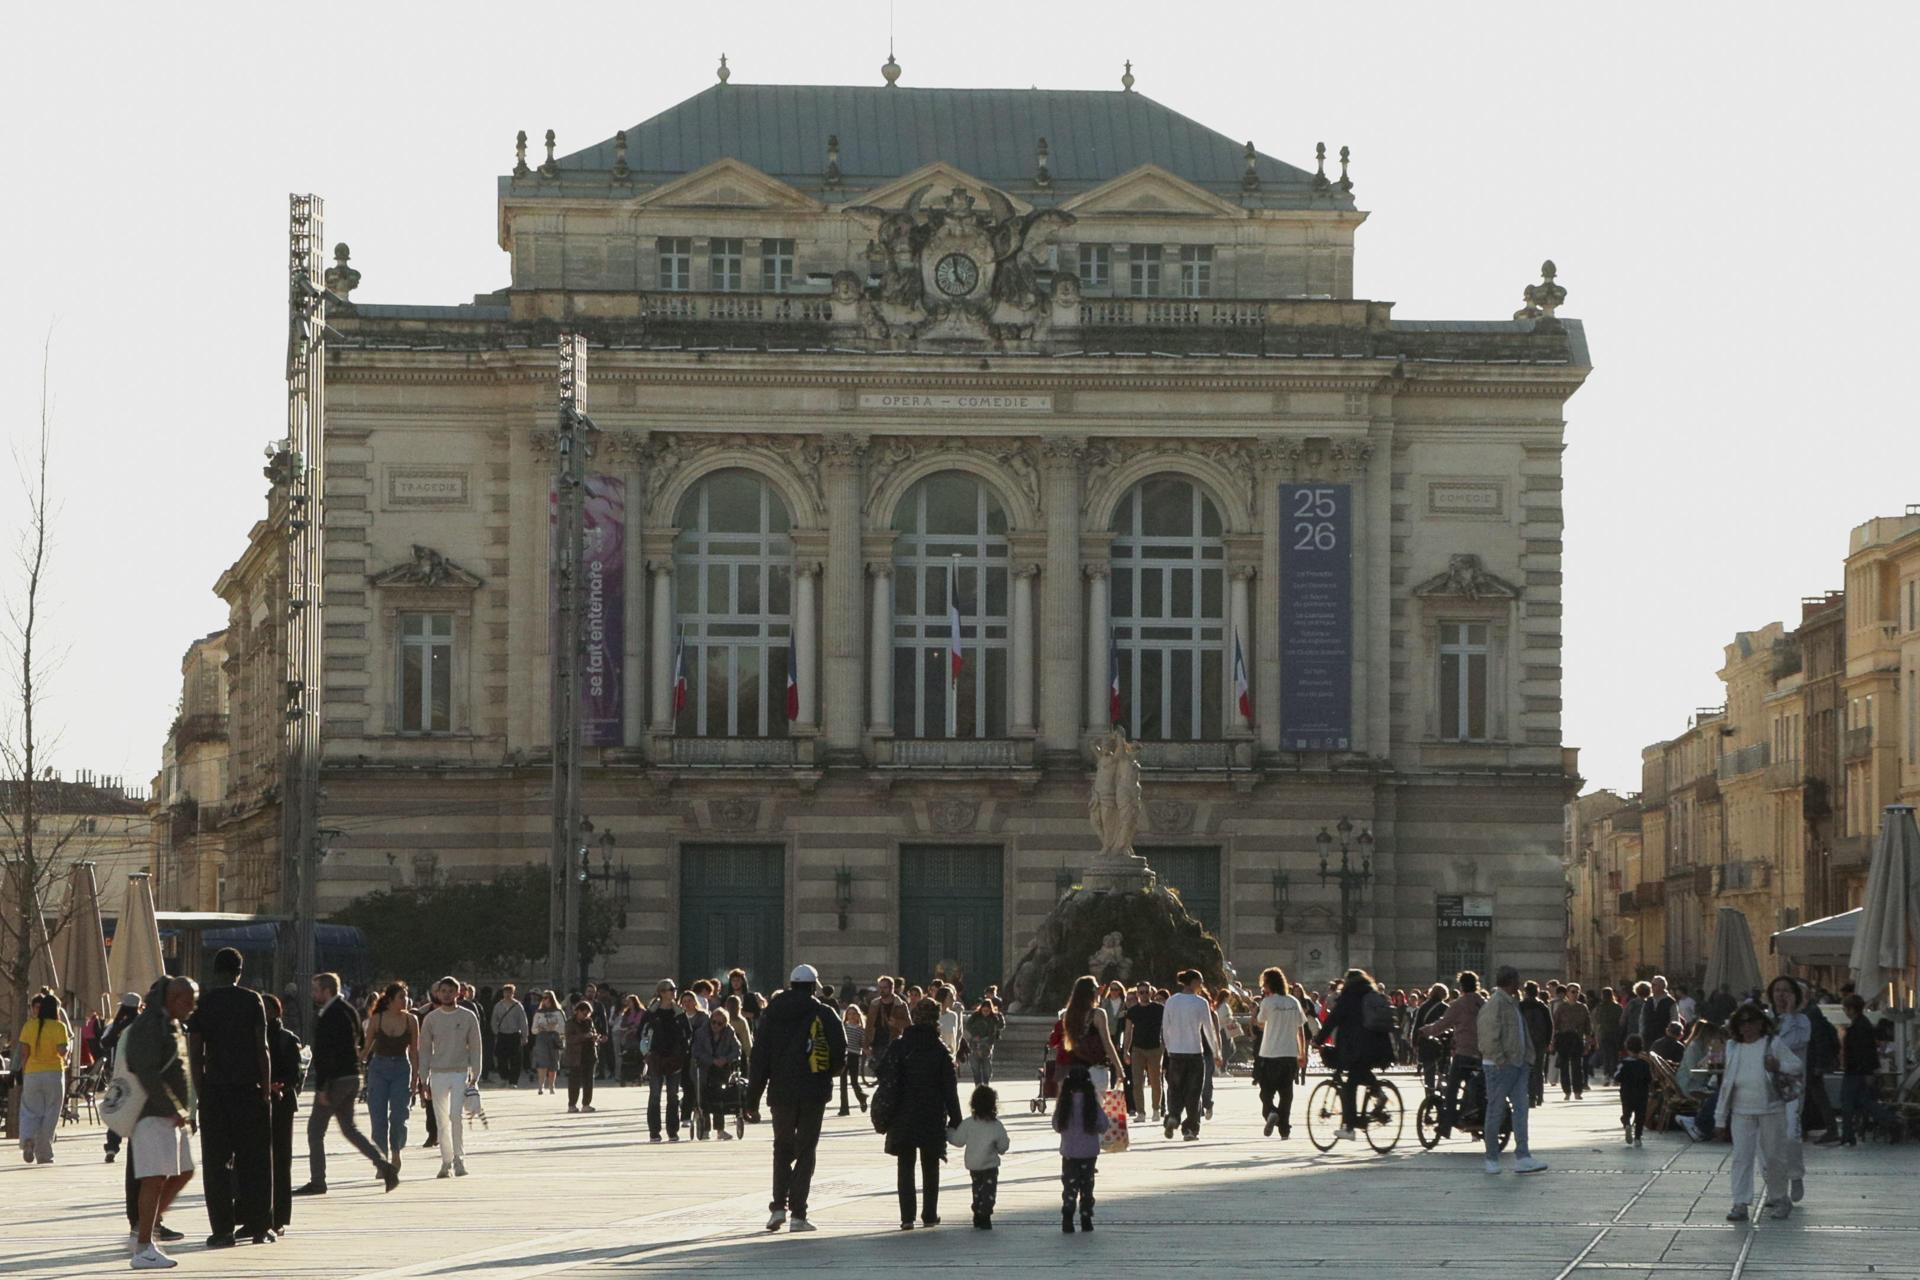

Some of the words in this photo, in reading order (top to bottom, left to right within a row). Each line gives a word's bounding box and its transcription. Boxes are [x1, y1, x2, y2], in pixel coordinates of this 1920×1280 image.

[882, 396, 932, 406] OPERA
[958, 397, 1029, 408] COMEDIE
[1293, 489, 1336, 518] 25
[1293, 522, 1336, 551] 26
[589, 676, 603, 697] se
